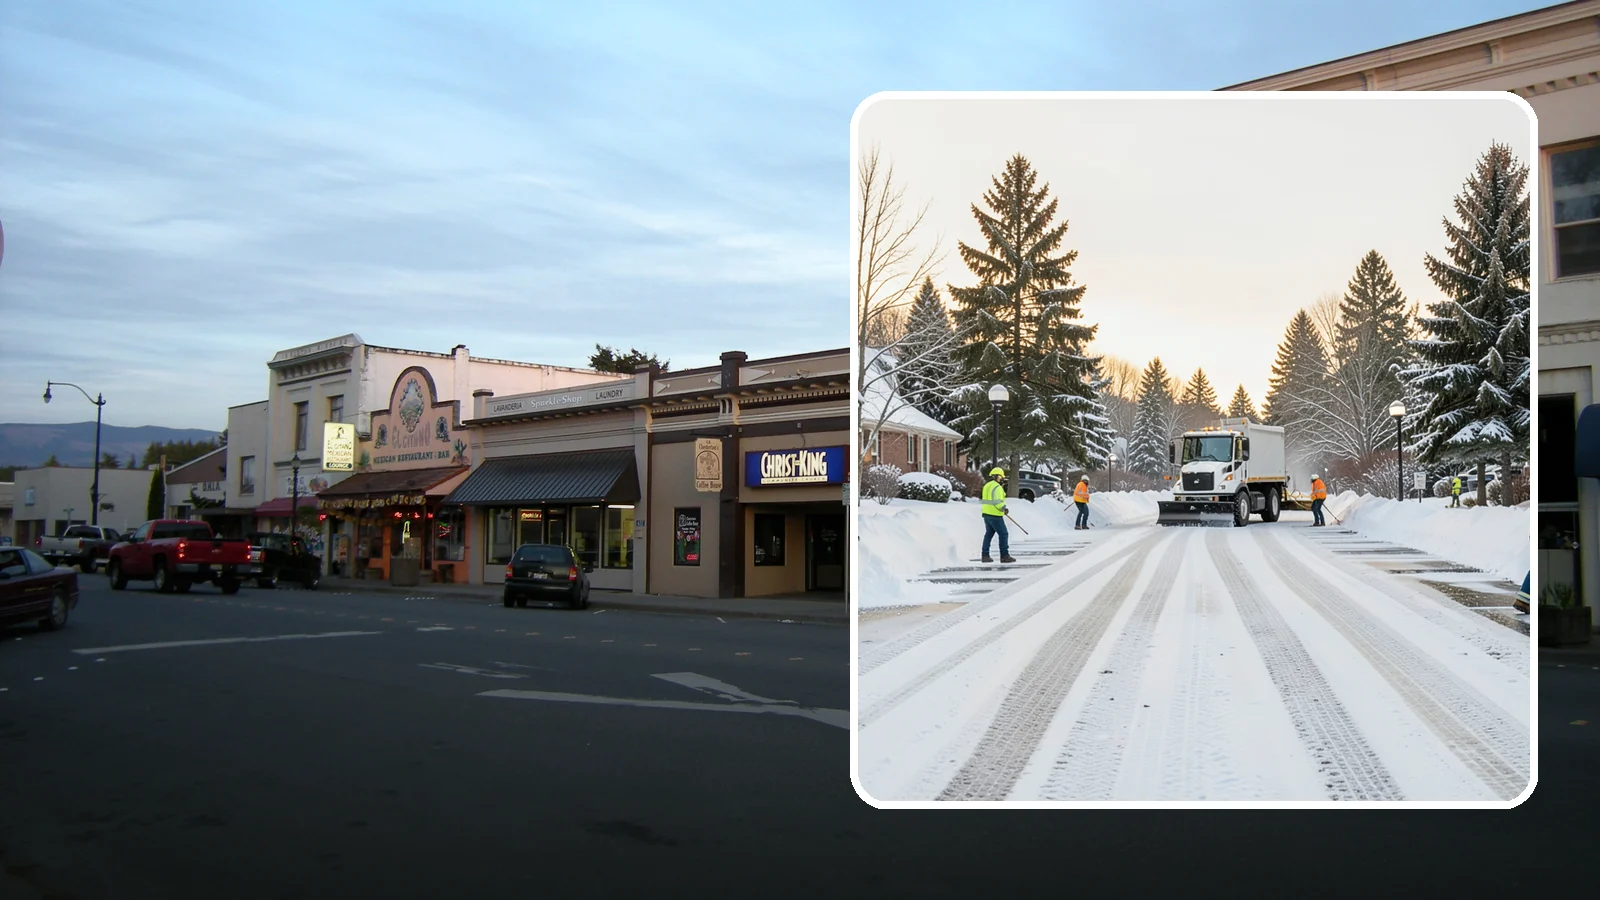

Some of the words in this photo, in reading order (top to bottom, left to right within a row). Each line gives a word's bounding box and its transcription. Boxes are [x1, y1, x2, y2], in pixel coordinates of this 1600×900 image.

[595, 389, 624, 400] LAUNDRY
[493, 402, 523, 412] LAVANDERIA
[397, 451, 434, 463] RESTAURANT
[761, 452, 797, 478] CHRIST
[799, 450, 828, 476] KING
